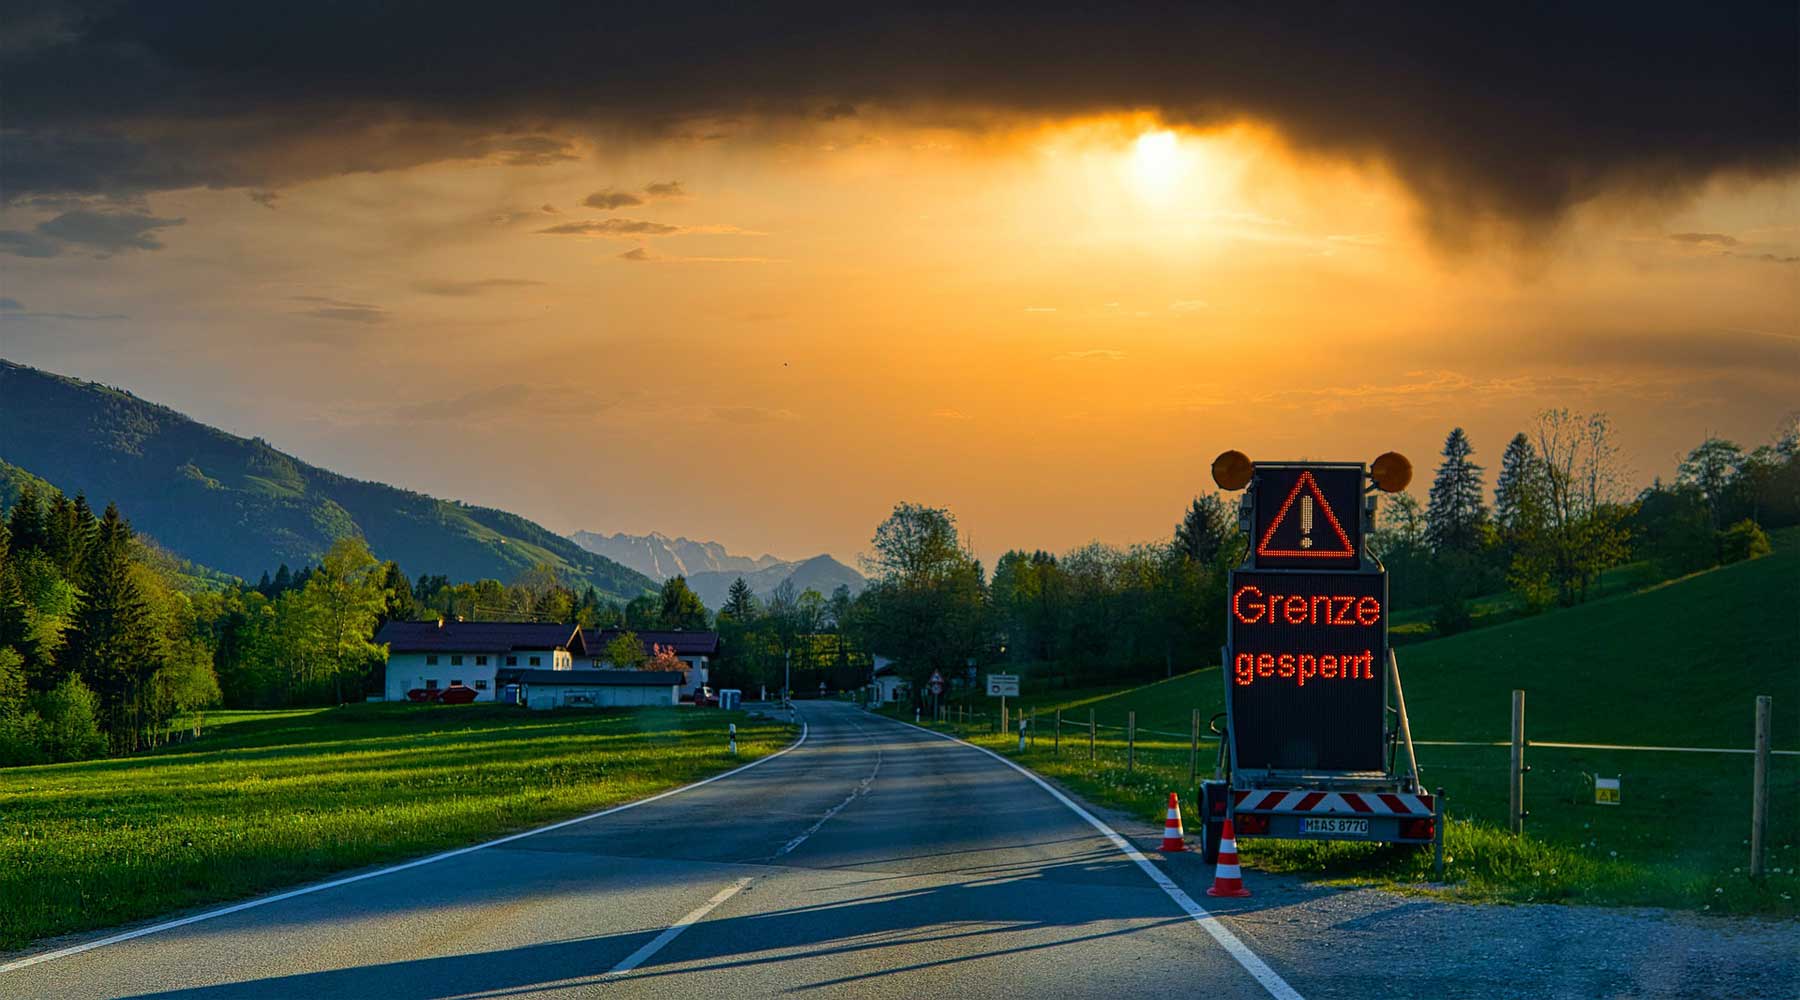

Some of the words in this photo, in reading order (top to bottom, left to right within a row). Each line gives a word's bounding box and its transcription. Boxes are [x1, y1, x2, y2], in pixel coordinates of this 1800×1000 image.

[1233, 585, 1380, 625] Grenze
[1235, 649, 1374, 687] gesperrt
[1339, 820, 1368, 832] 8770
